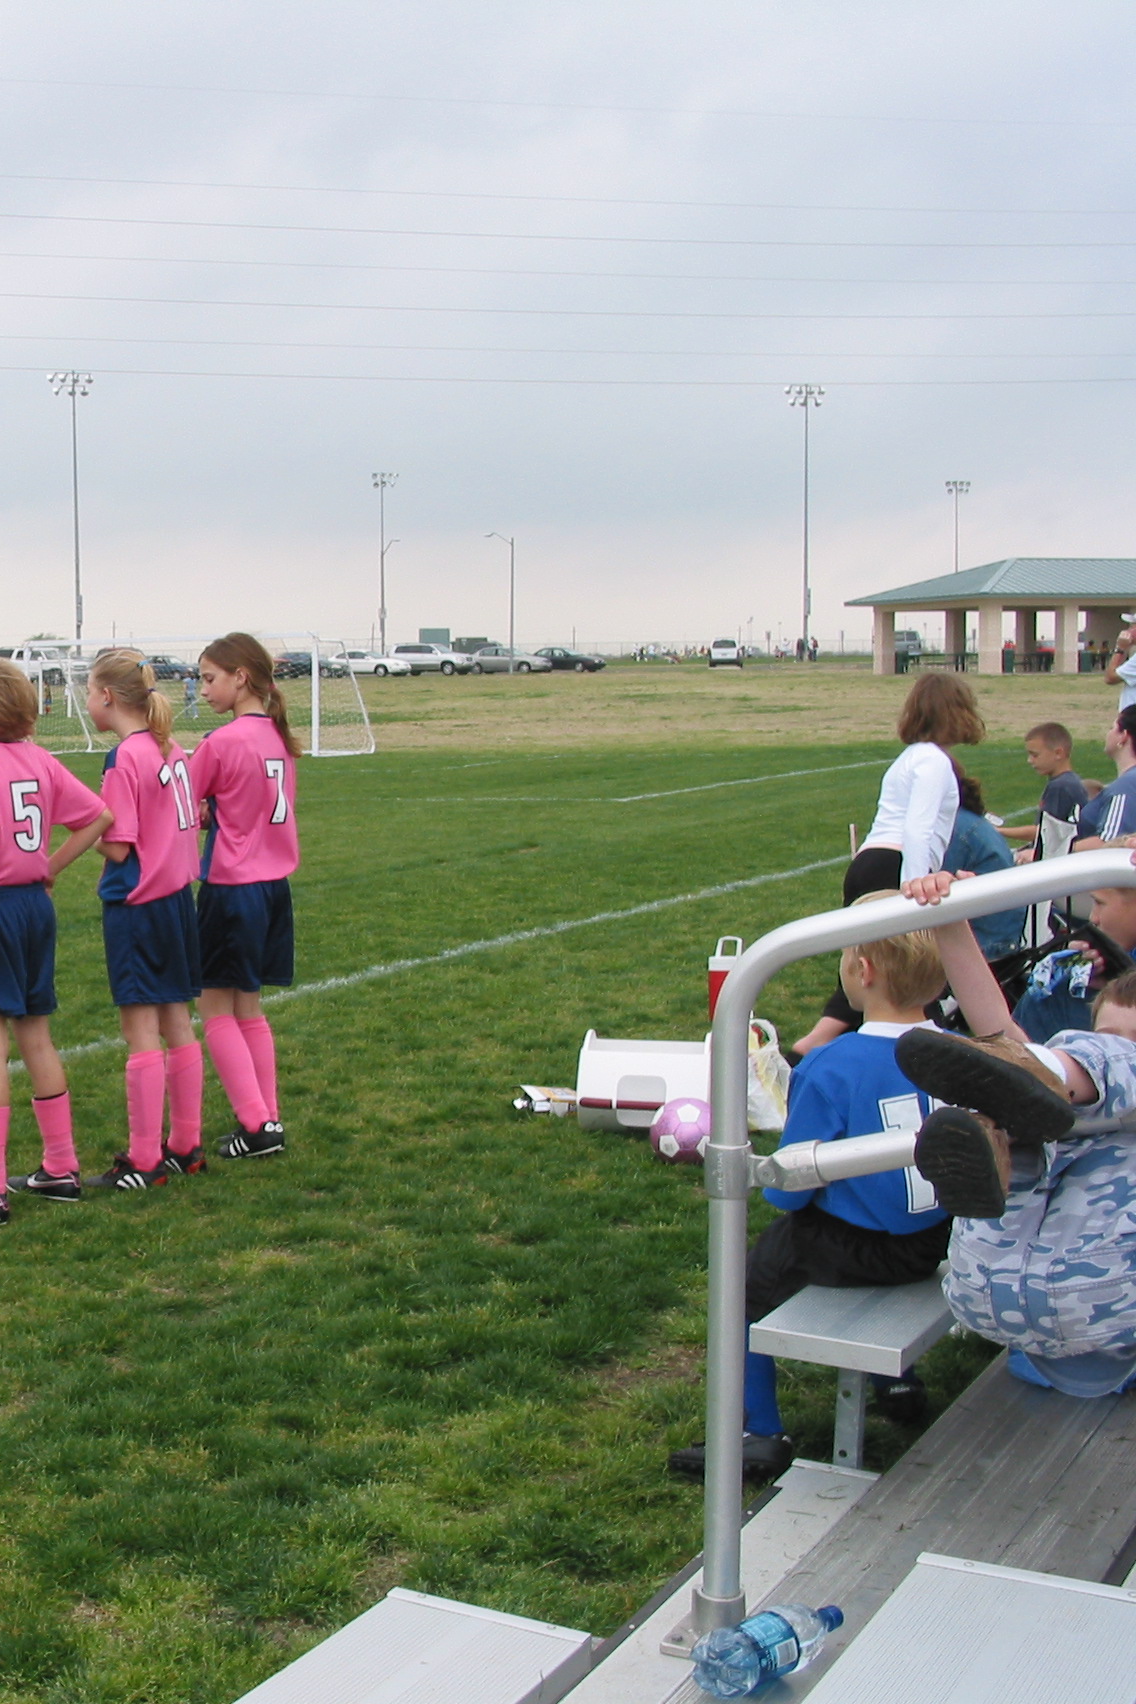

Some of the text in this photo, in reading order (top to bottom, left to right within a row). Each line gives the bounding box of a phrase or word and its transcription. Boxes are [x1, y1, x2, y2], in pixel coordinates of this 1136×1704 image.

[10, 779, 42, 852] 5
[157, 759, 198, 831] 11
[265, 758, 288, 824] 7
[877, 1092, 960, 1214] 1
